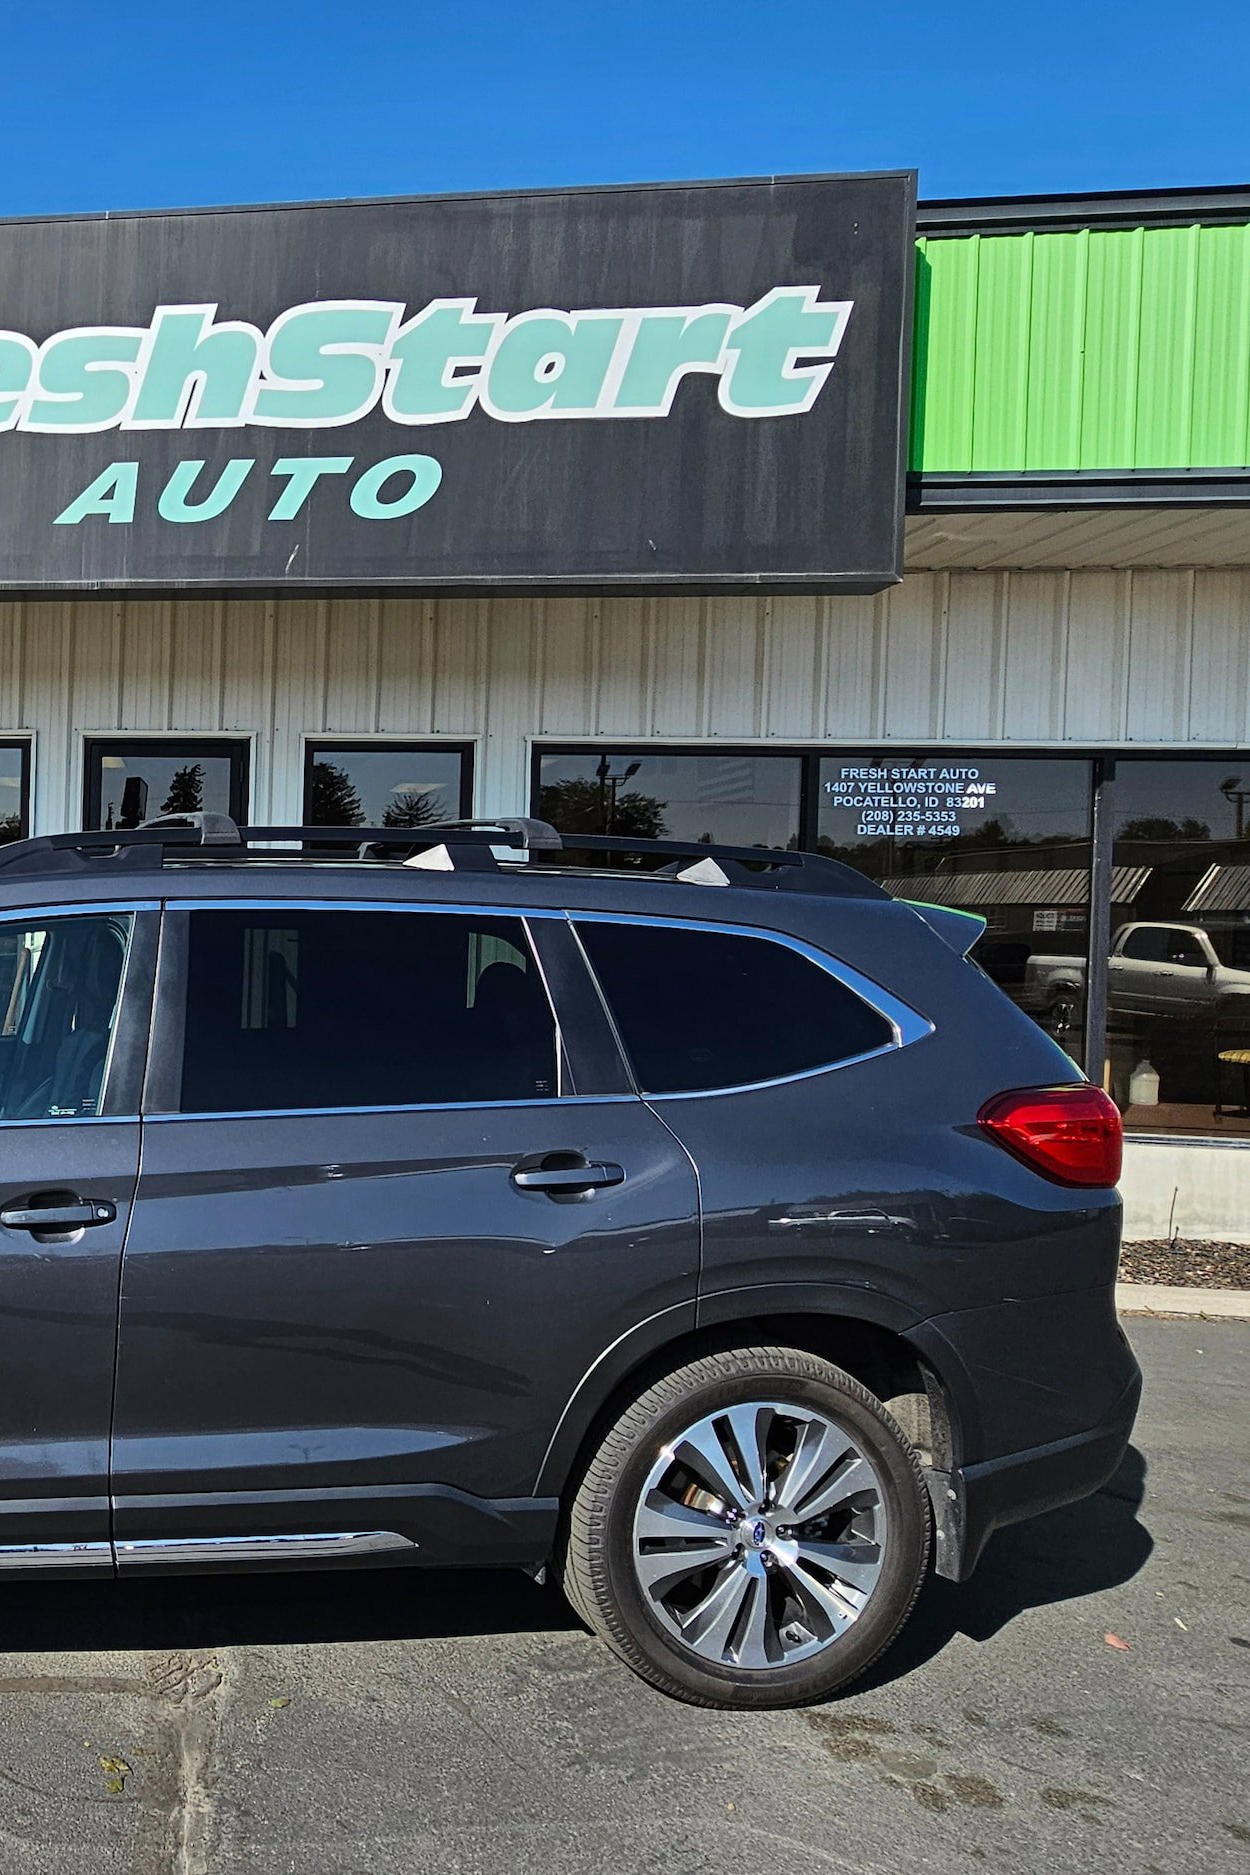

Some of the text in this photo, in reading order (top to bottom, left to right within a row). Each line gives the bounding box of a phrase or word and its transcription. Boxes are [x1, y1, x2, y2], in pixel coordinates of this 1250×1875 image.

[53, 453, 443, 526] AUTO
[840, 768, 979, 780] FRESH START AUTO
[824, 782, 997, 795] 1407 YELLOWSTONE AVE
[833, 796, 986, 809] POCATELLO, ID 83201
[861, 810, 957, 823] (208) 235-5353
[856, 824, 961, 836] DEALER # 4549
